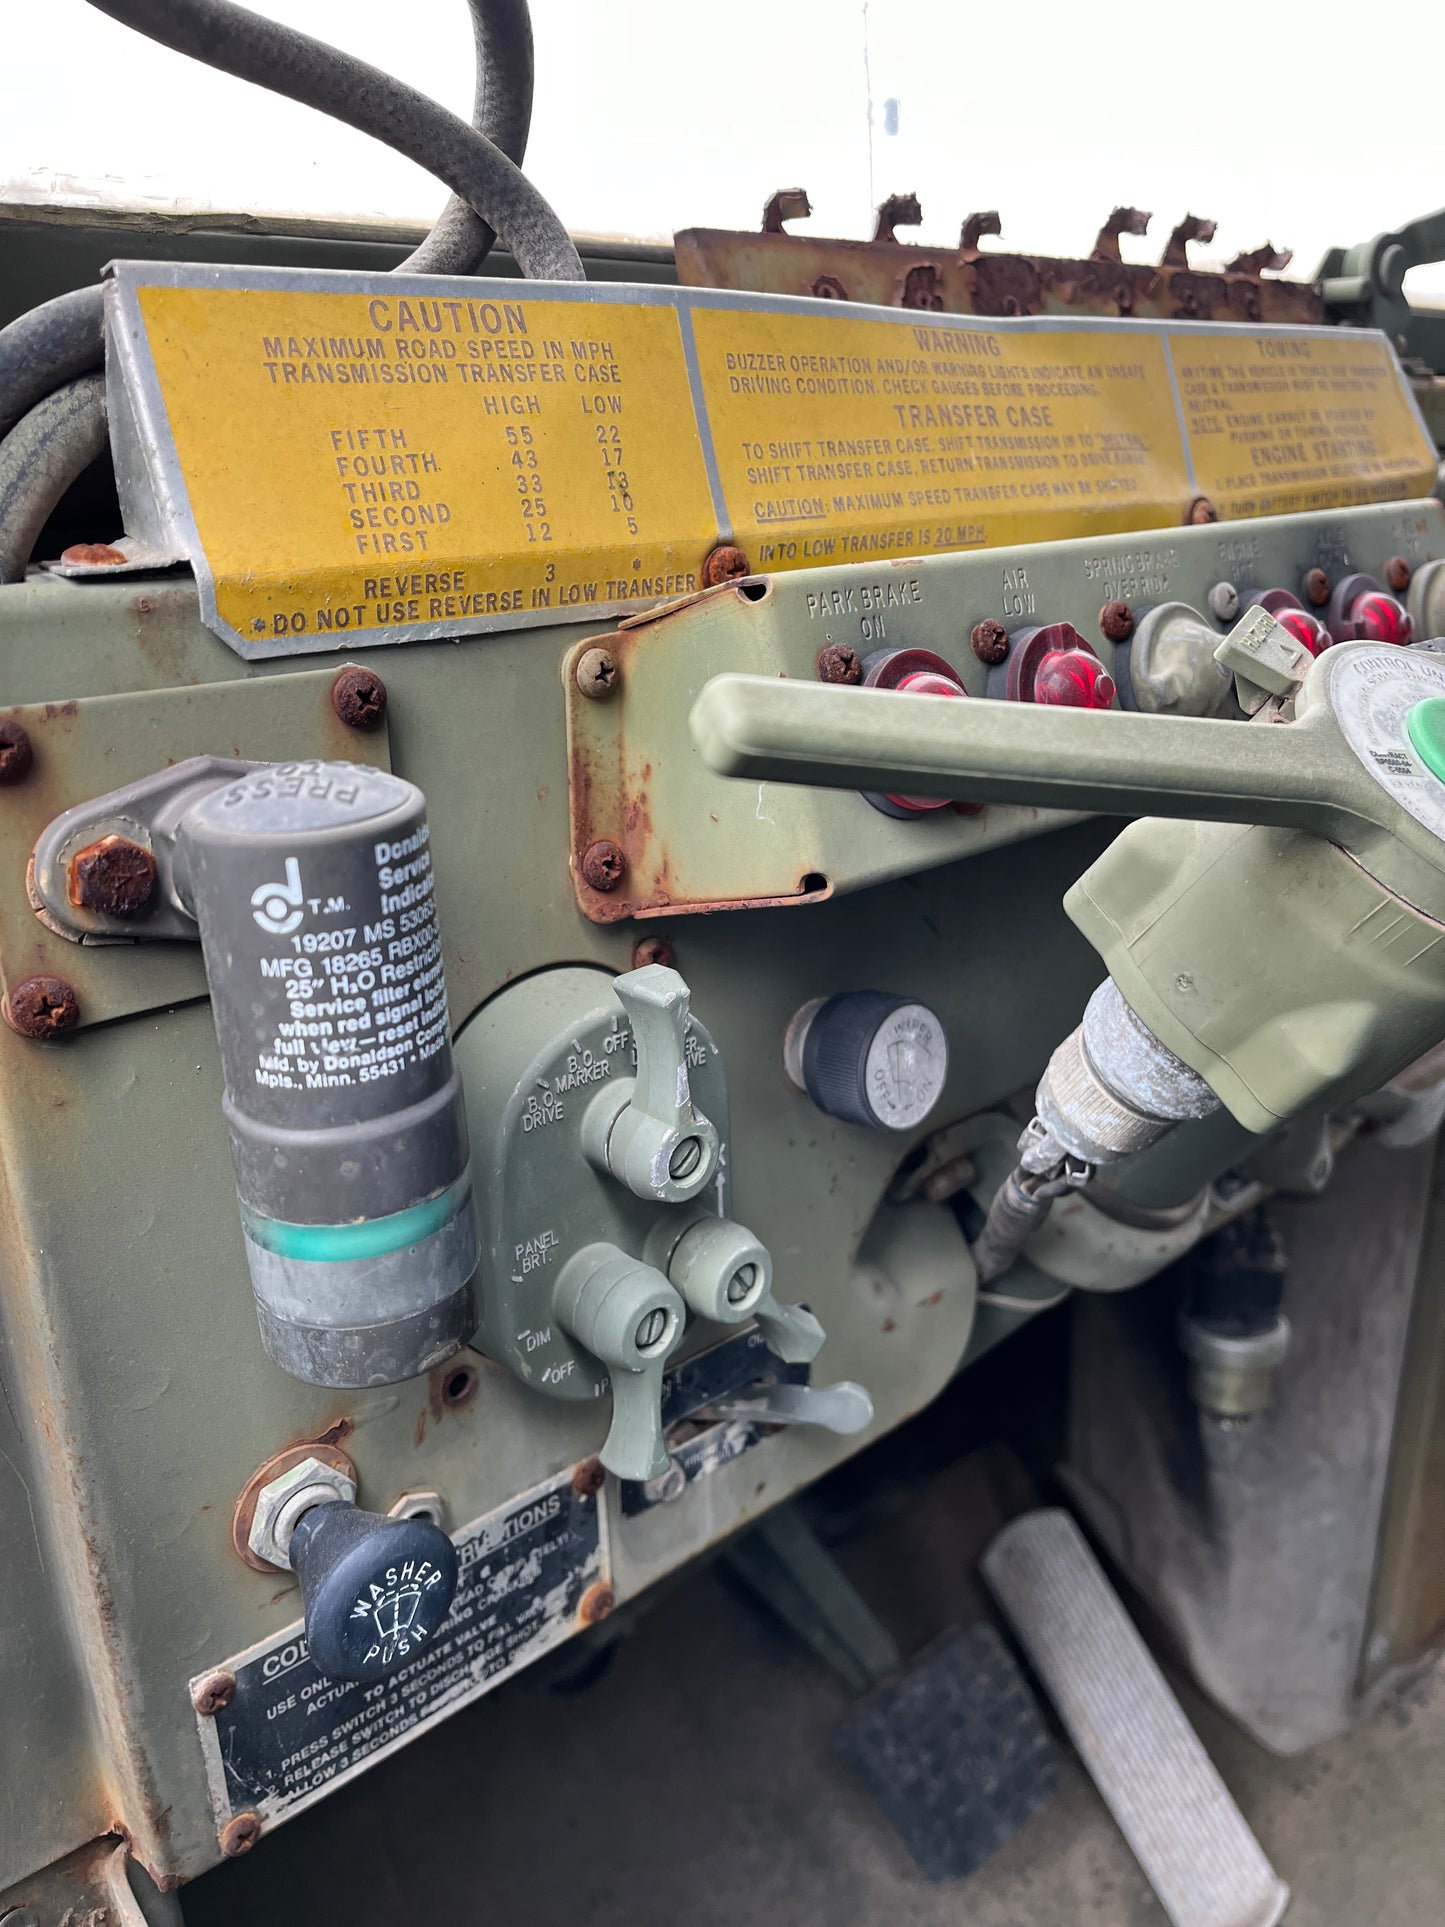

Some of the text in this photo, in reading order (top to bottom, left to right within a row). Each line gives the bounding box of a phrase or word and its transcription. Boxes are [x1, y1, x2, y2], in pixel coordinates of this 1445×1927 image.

[368, 299, 528, 334] CAUTION
[263, 336, 615, 361] MAXIMUM ROAD SPEED IN MPH
[912, 327, 1001, 357] WARNING
[263, 362, 622, 384] TRANSMISSION TRANSFER CASE
[726, 352, 786, 373] BUZZER
[790, 354, 871, 375] OPERATION
[877, 358, 928, 375] AND/OR
[730, 375, 792, 395] DRIVING
[882, 380, 928, 396] CHECK
[931, 382, 981, 397] GAUGES
[483, 394, 623, 415] HIGH LOW
[893, 404, 1054, 429] TRANSFER CASE
[330, 425, 622, 451] FIFTH 55 22
[742, 442, 765, 460] TO
[768, 440, 812, 459] SHIFT
[817, 439, 892, 457] TRANSFER
[938, 436, 974, 454] SHIFT
[336, 447, 623, 477] FOURTH 43 17
[746, 465, 791, 485] SHIFT
[796, 462, 872, 482] TRANSFER
[920, 457, 974, 475] RETURN
[342, 480, 420, 504] THIRD
[516, 473, 543, 494] 33
[833, 492, 903, 513] MAXIMUM
[908, 488, 952, 507] SPEED
[954, 483, 1018, 500] TRANSFER
[1020, 481, 1050, 498] CASE
[350, 494, 634, 530] SECOND 25 10
[356, 516, 638, 555] FIRST 12 5
[757, 541, 798, 563] INTO
[803, 538, 835, 558] LOW
[842, 533, 914, 555] TRANSFER
[918, 530, 932, 547] IS
[935, 527, 954, 545] 20
[364, 562, 556, 600] REVERSE 3
[1003, 568, 1031, 590] AIR
[1084, 554, 1134, 580] SPRING
[317, 605, 367, 631] NOT
[376, 600, 419, 624] USE
[428, 590, 523, 618] REVERSE
[531, 588, 551, 607] IN
[558, 582, 598, 604] LOW
[605, 573, 697, 600] TRANSFER
[806, 580, 923, 618] PARK BRAKE
[1003, 594, 1035, 617] LOW
[860, 616, 886, 640] ON
[291, 927, 357, 954] 19207
[363, 919, 396, 945] MS
[260, 950, 383, 979] MFG 18265
[279, 1019, 333, 1038] when
[337, 1013, 372, 1033] red
[375, 994, 423, 1026] signal
[290, 996, 367, 1019] Service
[371, 984, 410, 1008] filter
[274, 1036, 306, 1056] full
[297, 1050, 320, 1074] by
[323, 1037, 414, 1071] Donaldson
[604, 1030, 629, 1055] OFF
[306, 1066, 357, 1089] Minn.
[359, 1057, 405, 1082] 55431
[556, 1060, 610, 1095] MARKER
[522, 1102, 564, 1133] DRIVE
[515, 1230, 559, 1261] PANEL
[522, 1248, 552, 1274] BRT.
[527, 1327, 551, 1352] DIM
[552, 1360, 575, 1384] OFF
[350, 1560, 442, 1619] WASHER
[363, 1624, 428, 1665] PUSH
[364, 1684, 385, 1702] TO
[389, 1641, 453, 1689] ACTUATE
[456, 1614, 498, 1646] VALVE
[267, 1694, 298, 1720] USE
[281, 1735, 329, 1771] PRESS
[332, 1699, 387, 1741] SWITCH
[389, 1692, 399, 1704] 3
[401, 1652, 465, 1698] SECONDS
[467, 1639, 486, 1656] TO
[284, 1740, 349, 1787] RELEASE
[351, 1704, 405, 1744] SWITCH
[408, 1692, 428, 1709] TO
[286, 1714, 418, 1800] ALLOW 3 SECONDS
